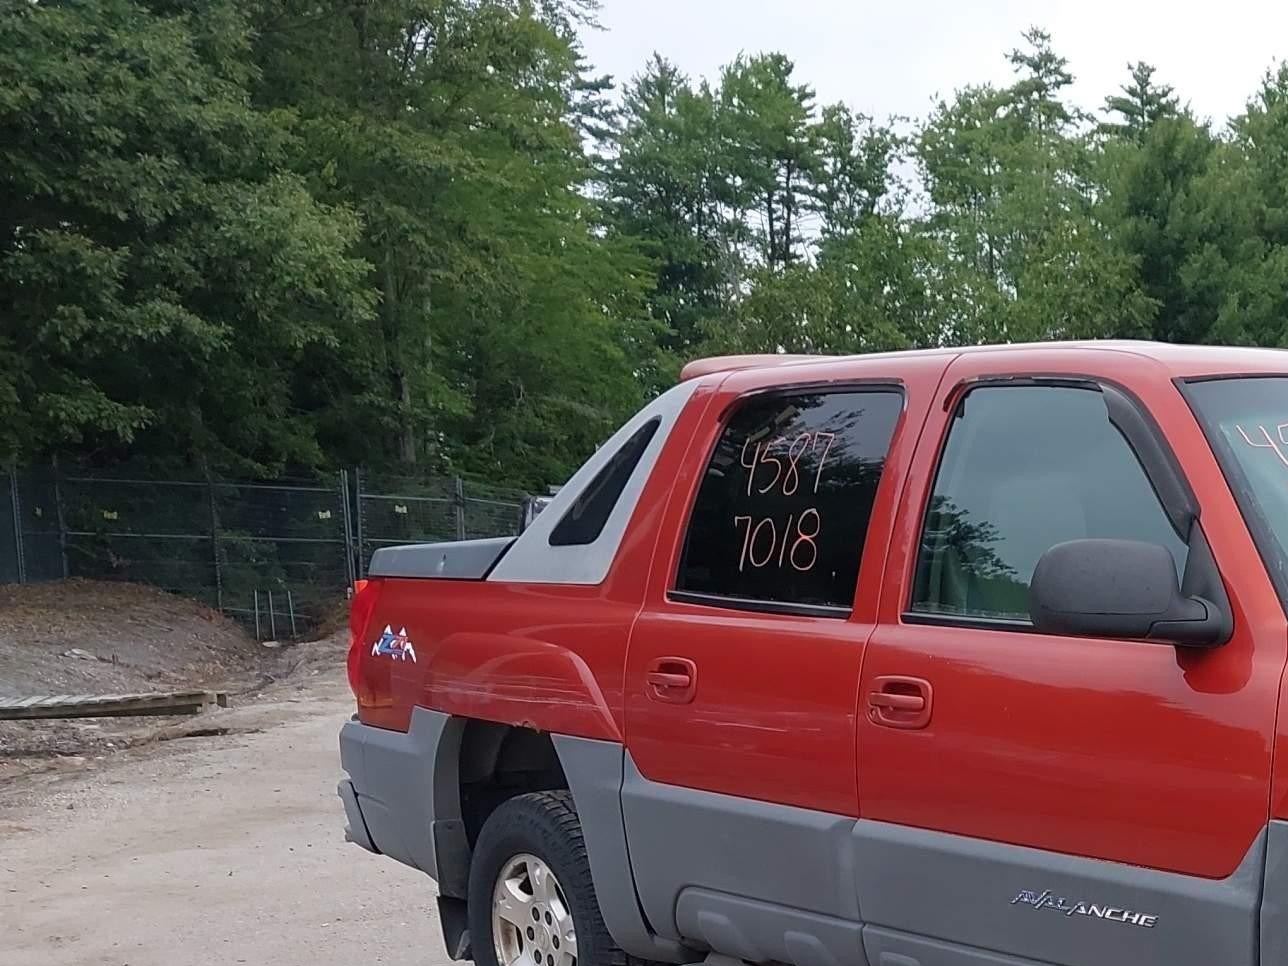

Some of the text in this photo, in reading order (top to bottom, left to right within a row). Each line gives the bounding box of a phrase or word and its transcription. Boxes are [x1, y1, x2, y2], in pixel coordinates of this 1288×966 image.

[740, 432, 835, 497] 4587
[734, 507, 821, 572] 7018
[1010, 888, 1160, 929] AVALANCHE
